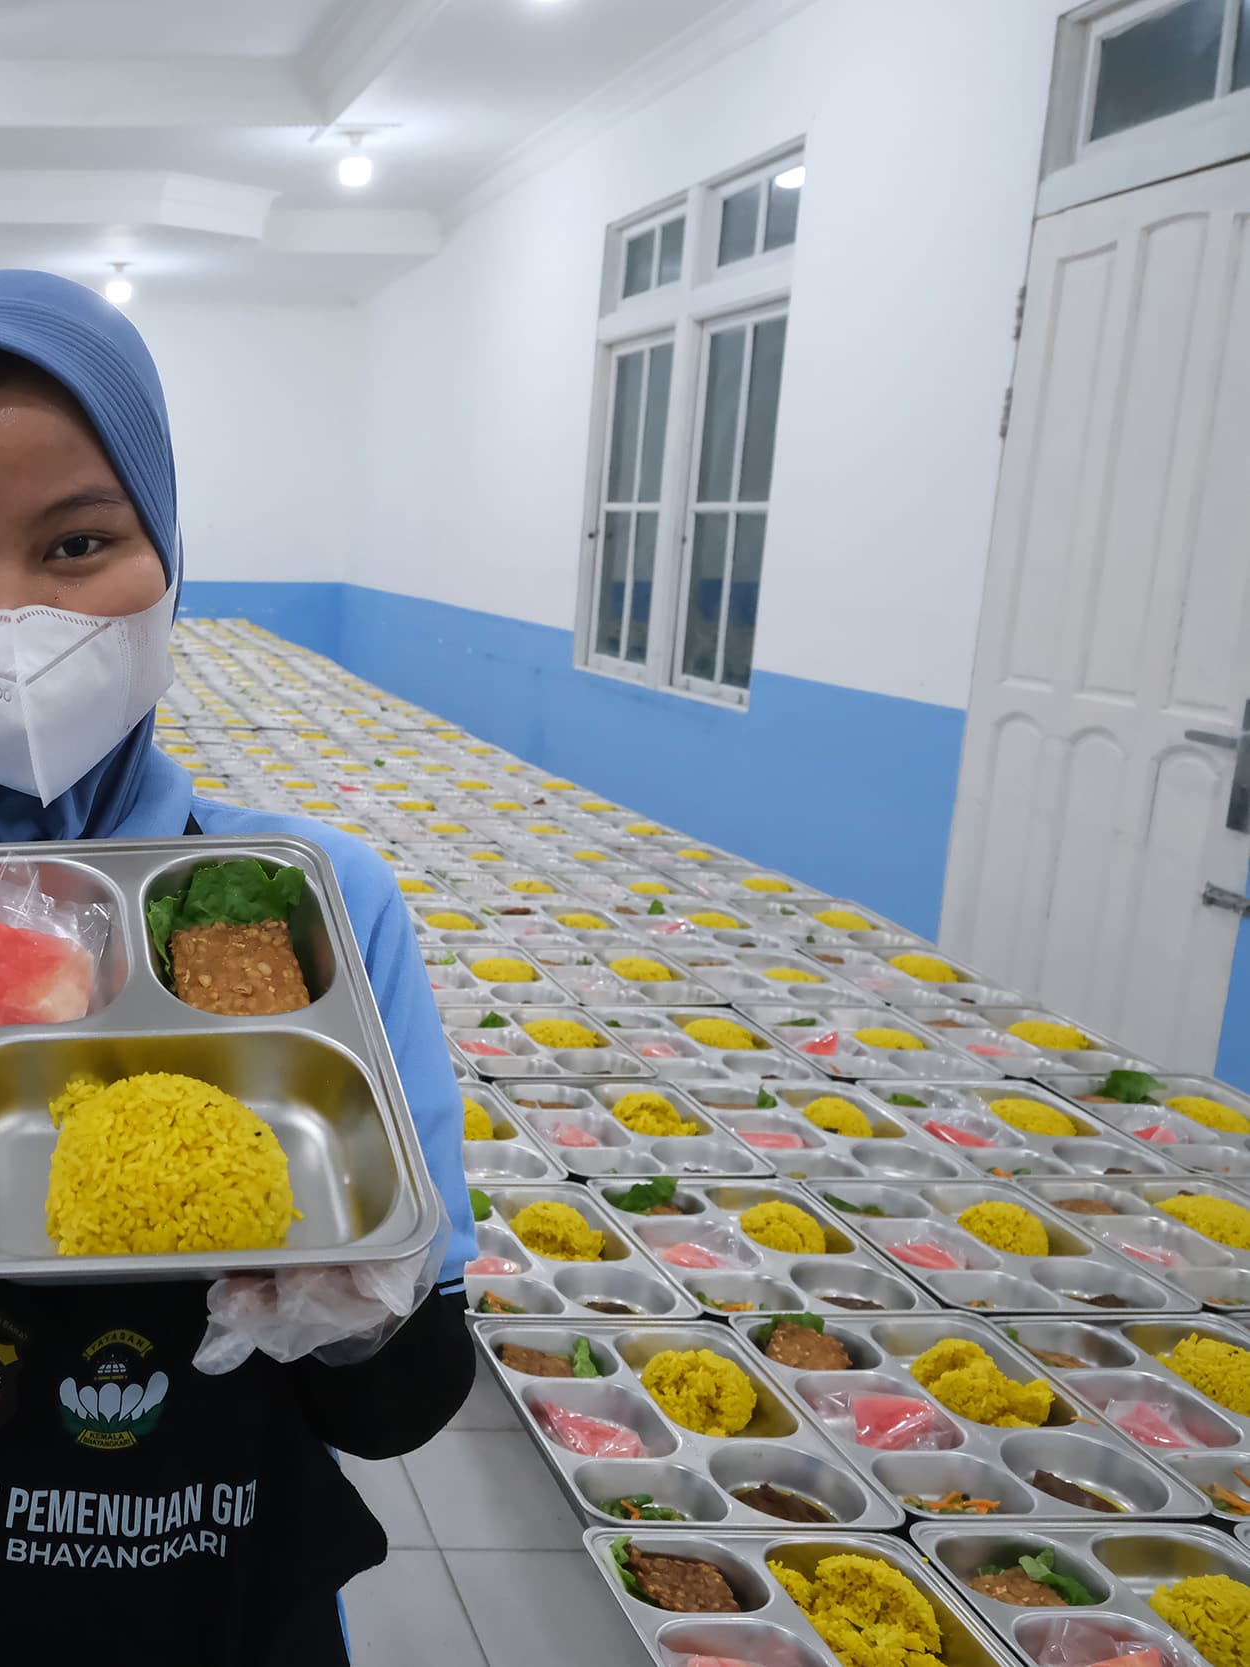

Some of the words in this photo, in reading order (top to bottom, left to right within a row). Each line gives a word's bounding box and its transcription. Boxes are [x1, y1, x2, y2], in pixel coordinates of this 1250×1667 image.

[90, 1331, 144, 1353] YAYASAN
[5, 1483, 203, 1537] PEMENUHAN
[6, 1530, 227, 1568] BHAYANGKARI
